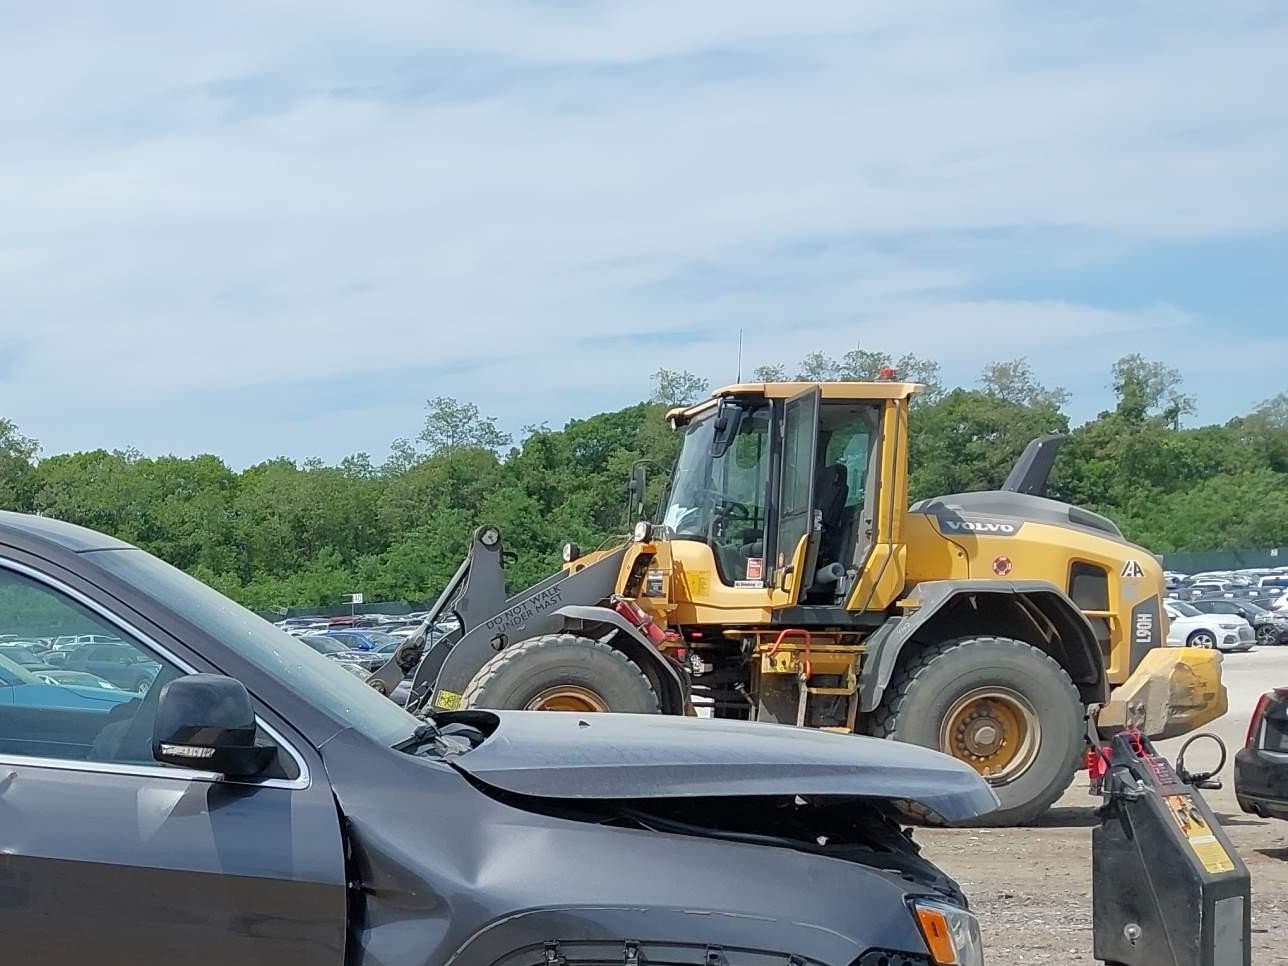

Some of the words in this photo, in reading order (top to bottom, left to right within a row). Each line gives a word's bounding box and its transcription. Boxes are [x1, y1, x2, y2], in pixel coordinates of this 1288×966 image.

[945, 521, 1014, 533] VOLVO
[486, 616, 503, 629] DO
[504, 603, 527, 619] NOT
[529, 584, 560, 604] WALK
[497, 610, 533, 632] UNDER
[535, 592, 562, 613] MAST
[1136, 613, 1153, 643] L90H
